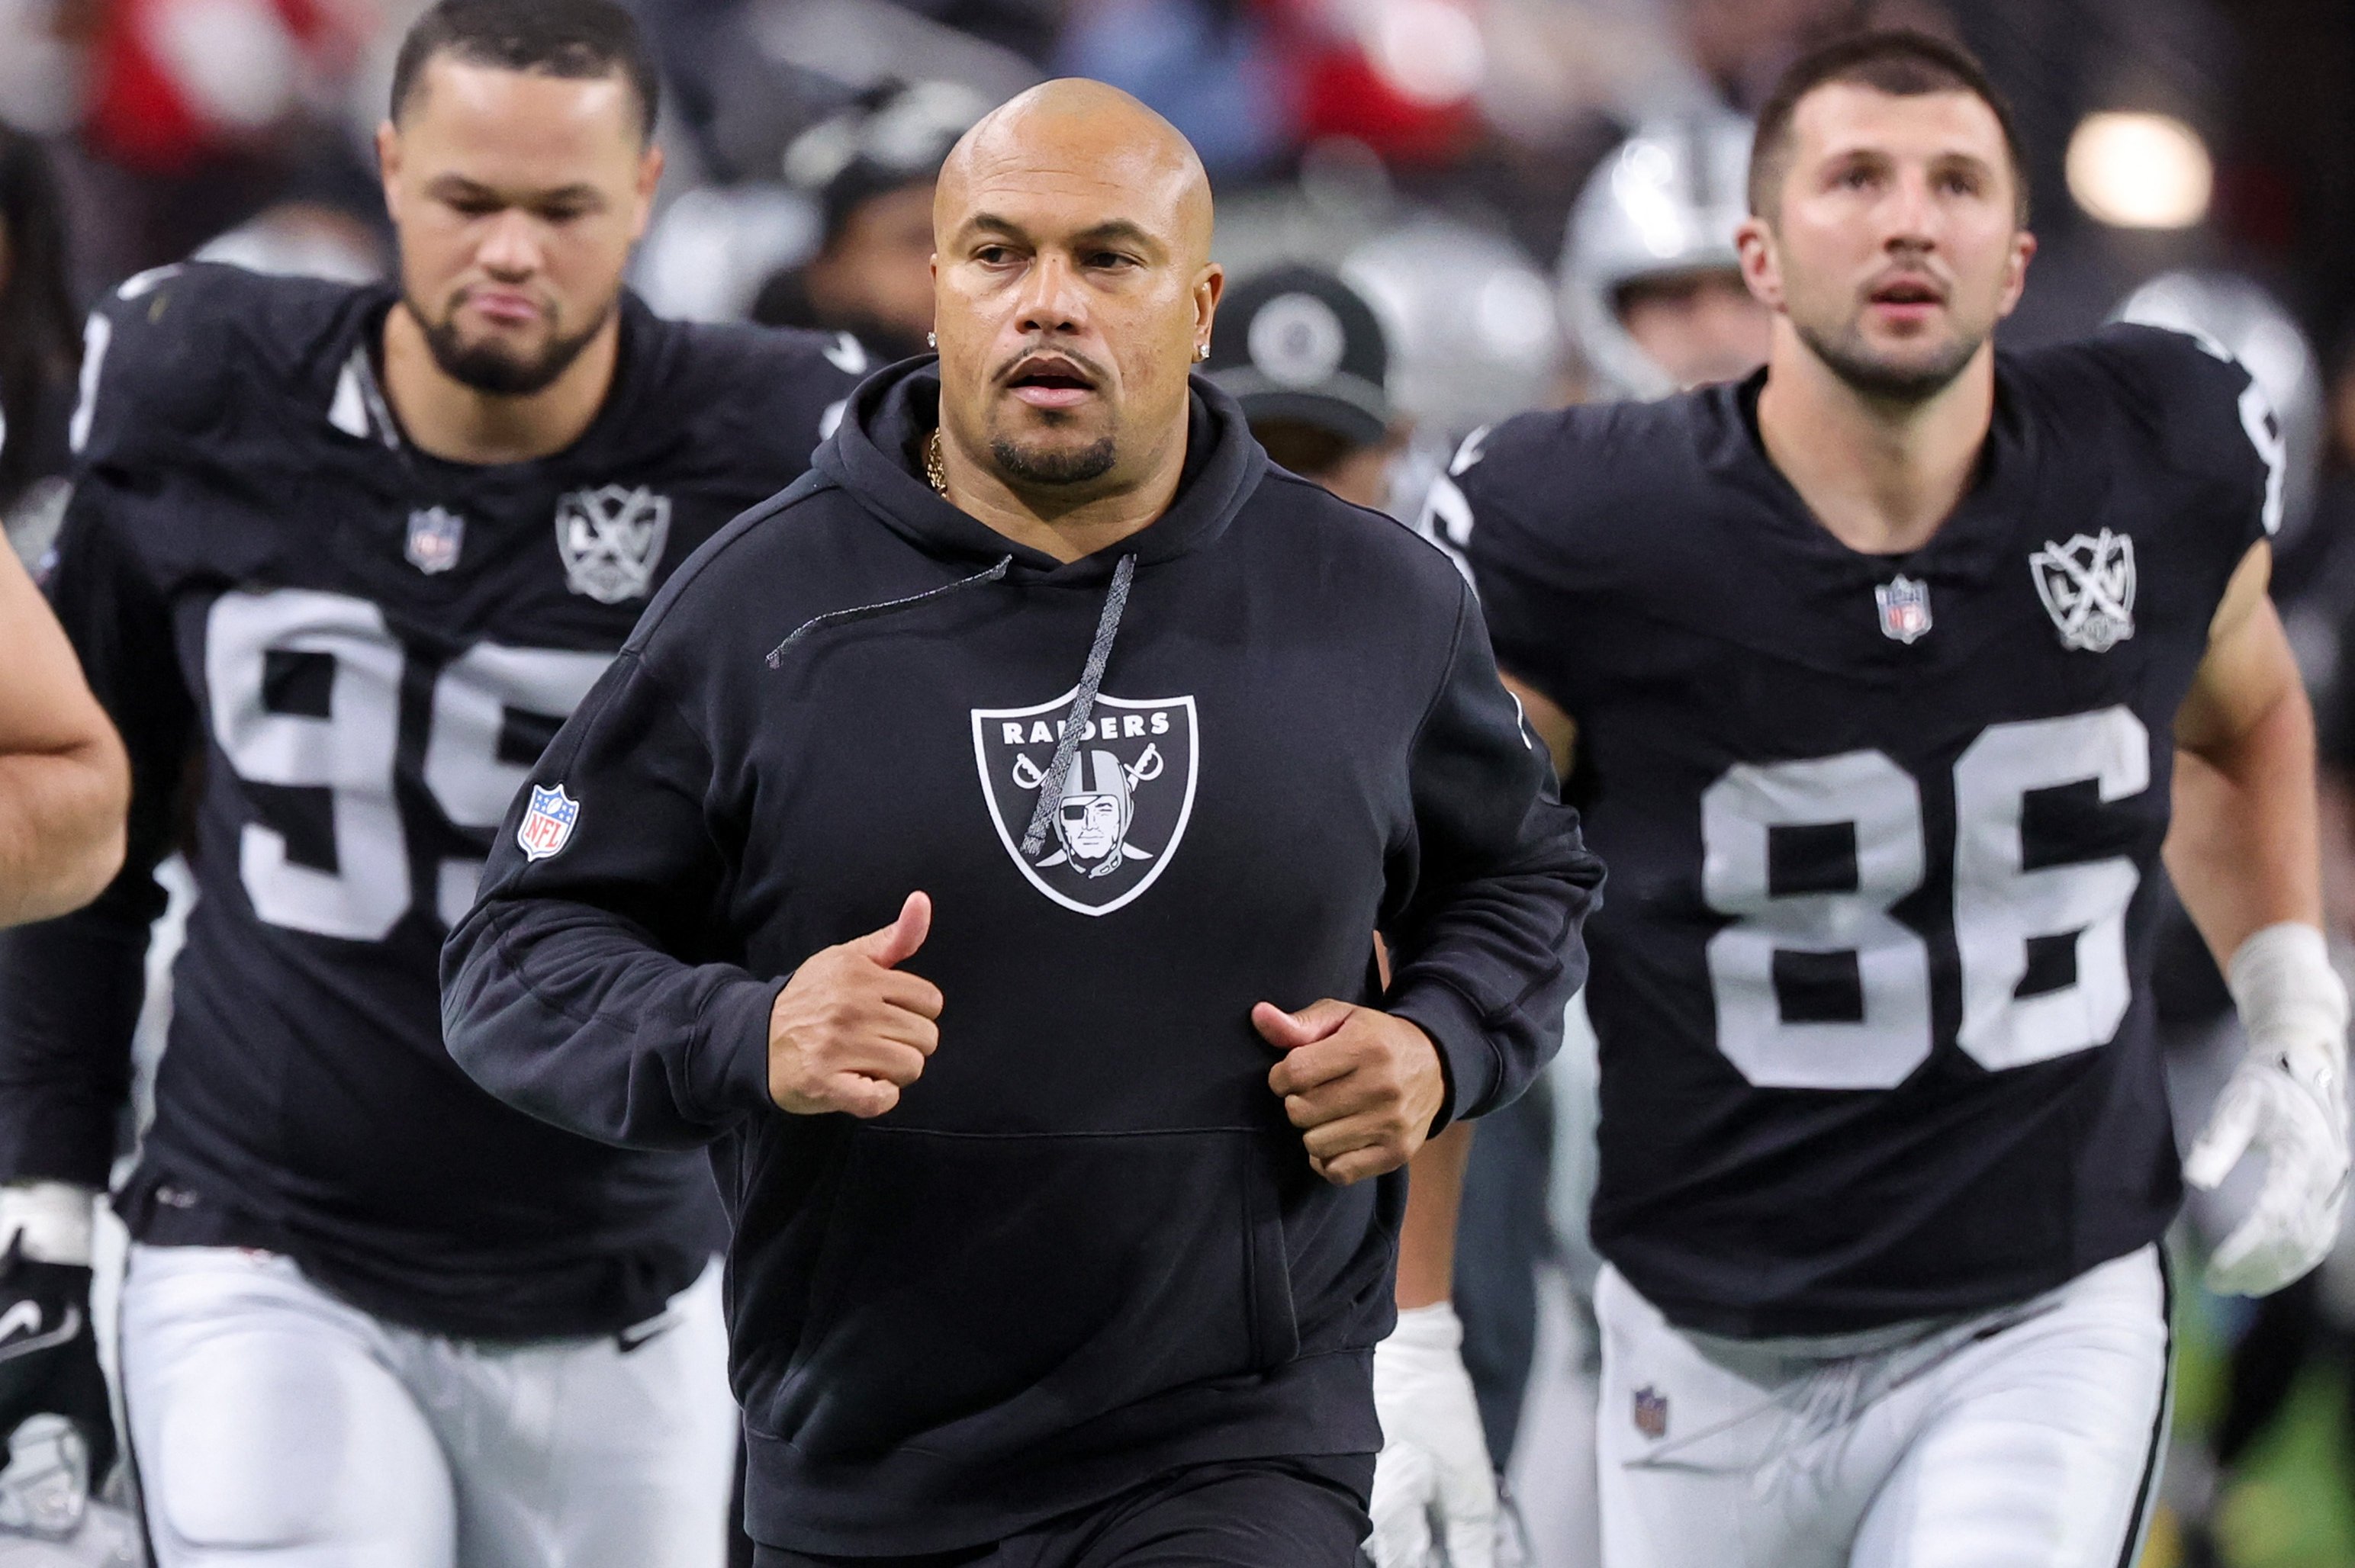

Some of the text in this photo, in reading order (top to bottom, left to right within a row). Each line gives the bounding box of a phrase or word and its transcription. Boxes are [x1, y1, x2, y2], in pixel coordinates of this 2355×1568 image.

[1002, 712, 1169, 744] RAIDERS
[525, 813, 561, 848] NFL
[1702, 705, 2151, 1090] 86
